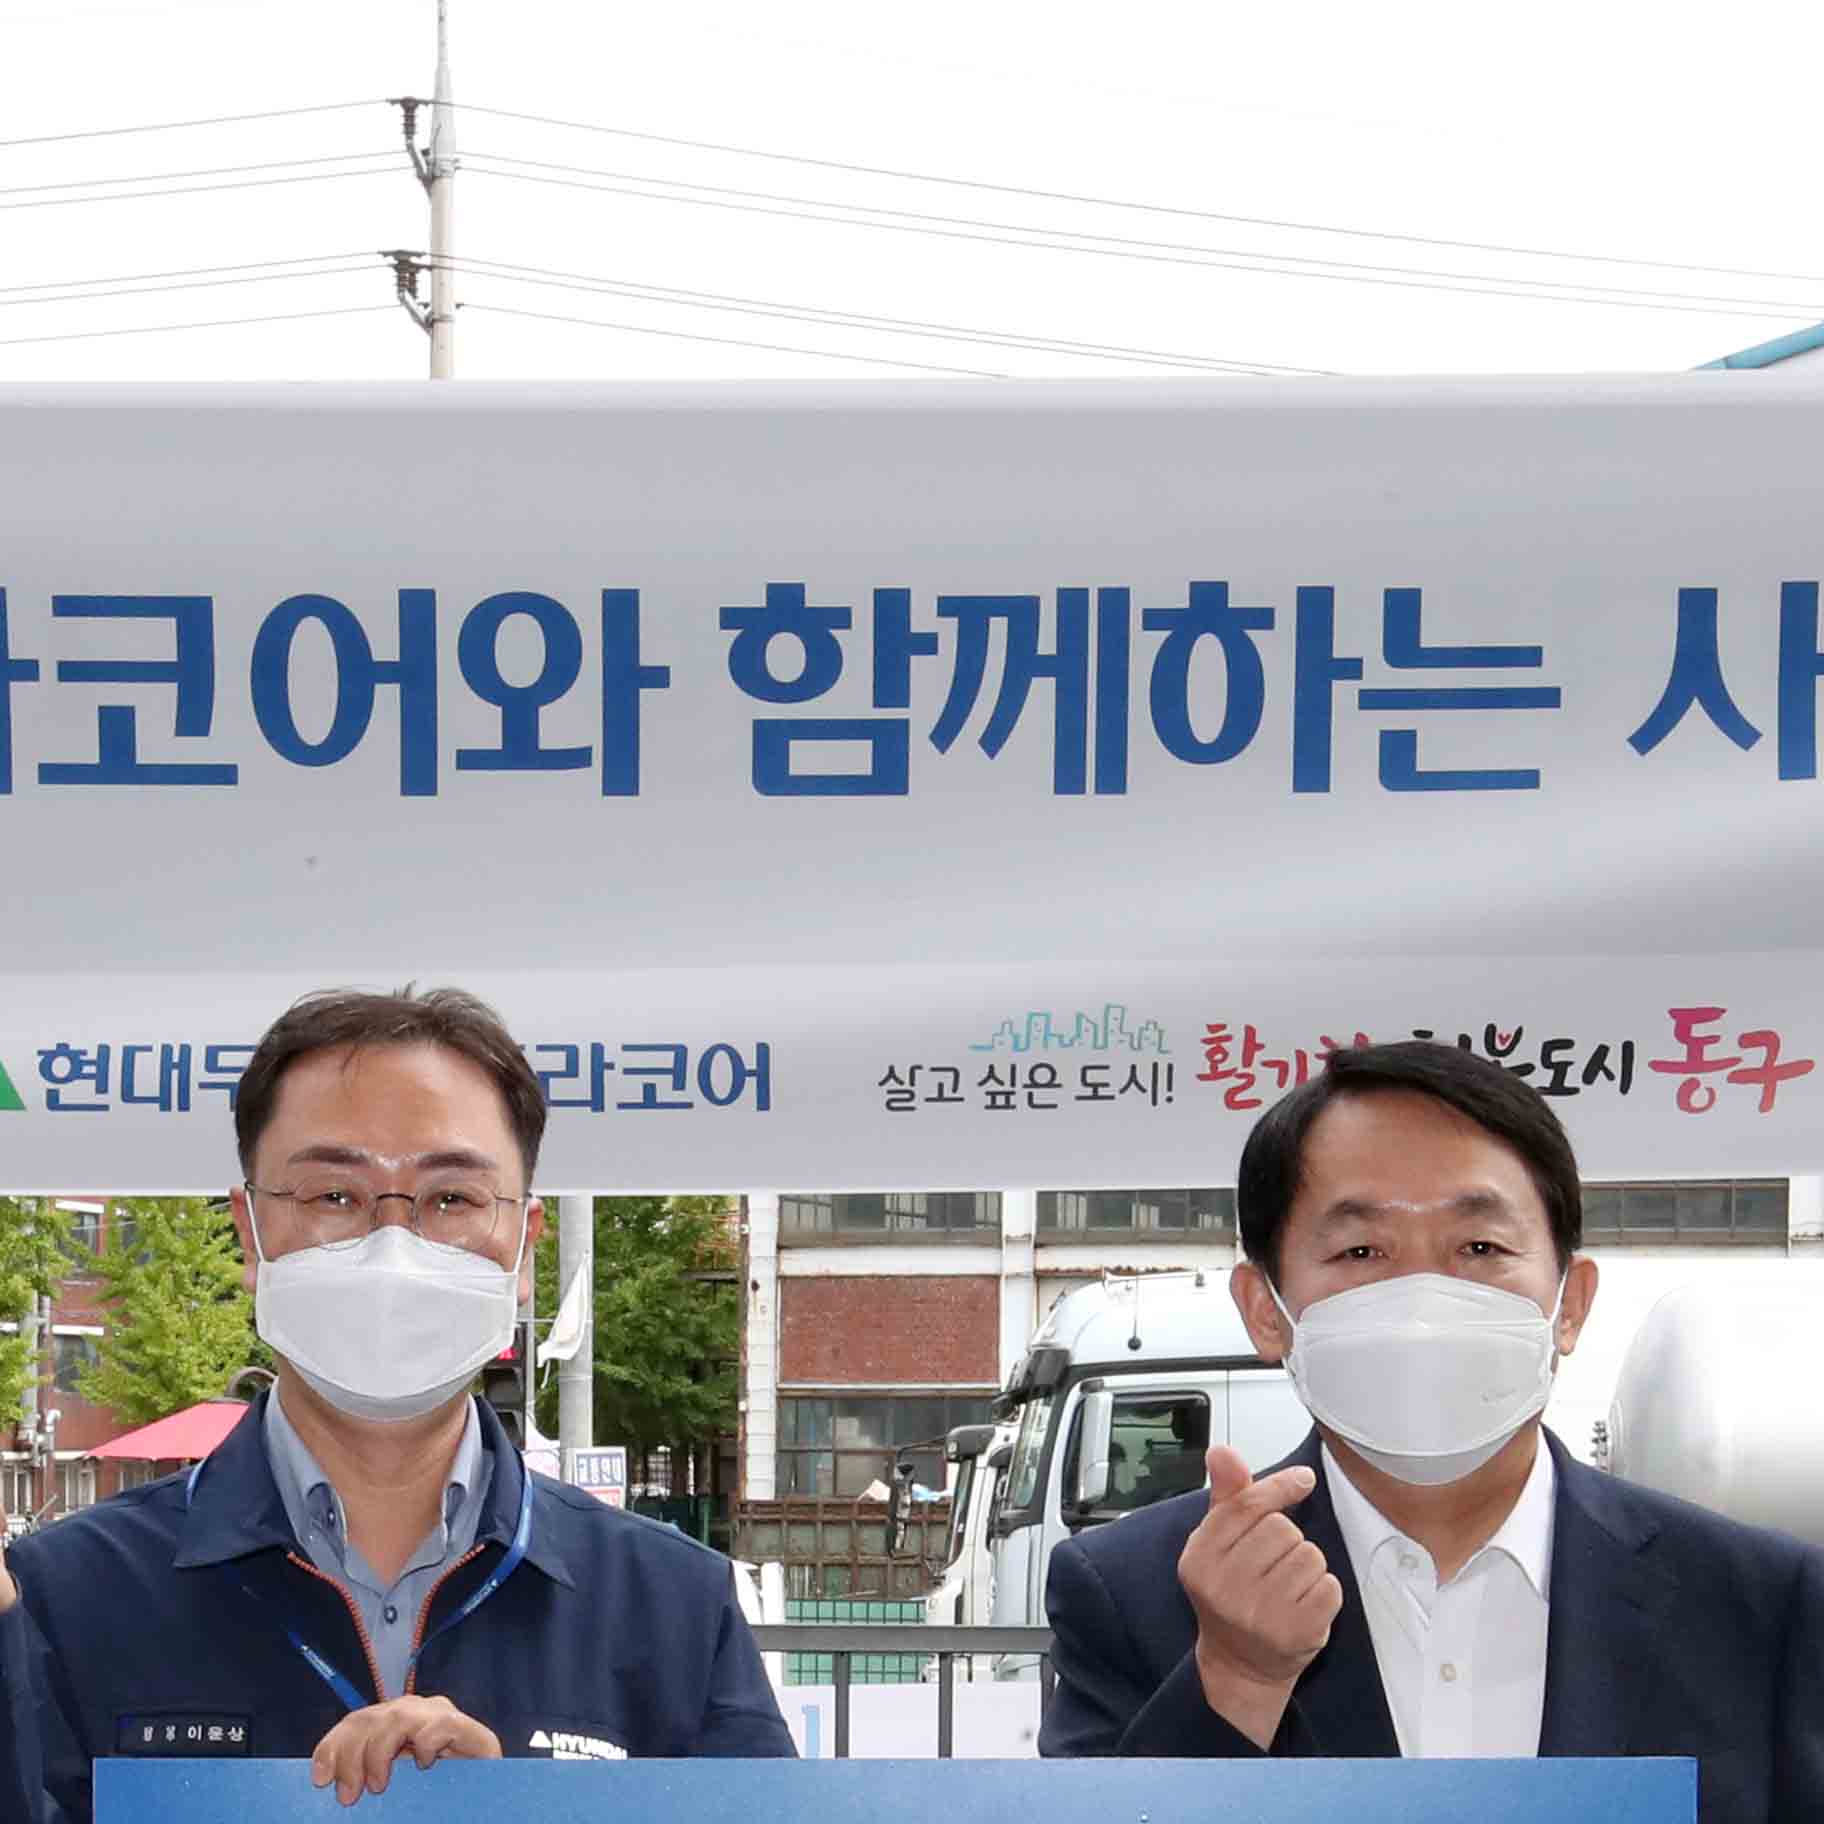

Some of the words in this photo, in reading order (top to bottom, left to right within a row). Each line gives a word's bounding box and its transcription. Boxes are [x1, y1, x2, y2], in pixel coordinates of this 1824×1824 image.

[718, 580, 1562, 798] 함께하는
[35, 1042, 772, 1113] 현대두라코어
[878, 1060, 965, 1113] 살고
[976, 1060, 1064, 1111] 싶은
[1074, 1059, 1175, 1107] 도시!
[1648, 1006, 1815, 1114] 동구
